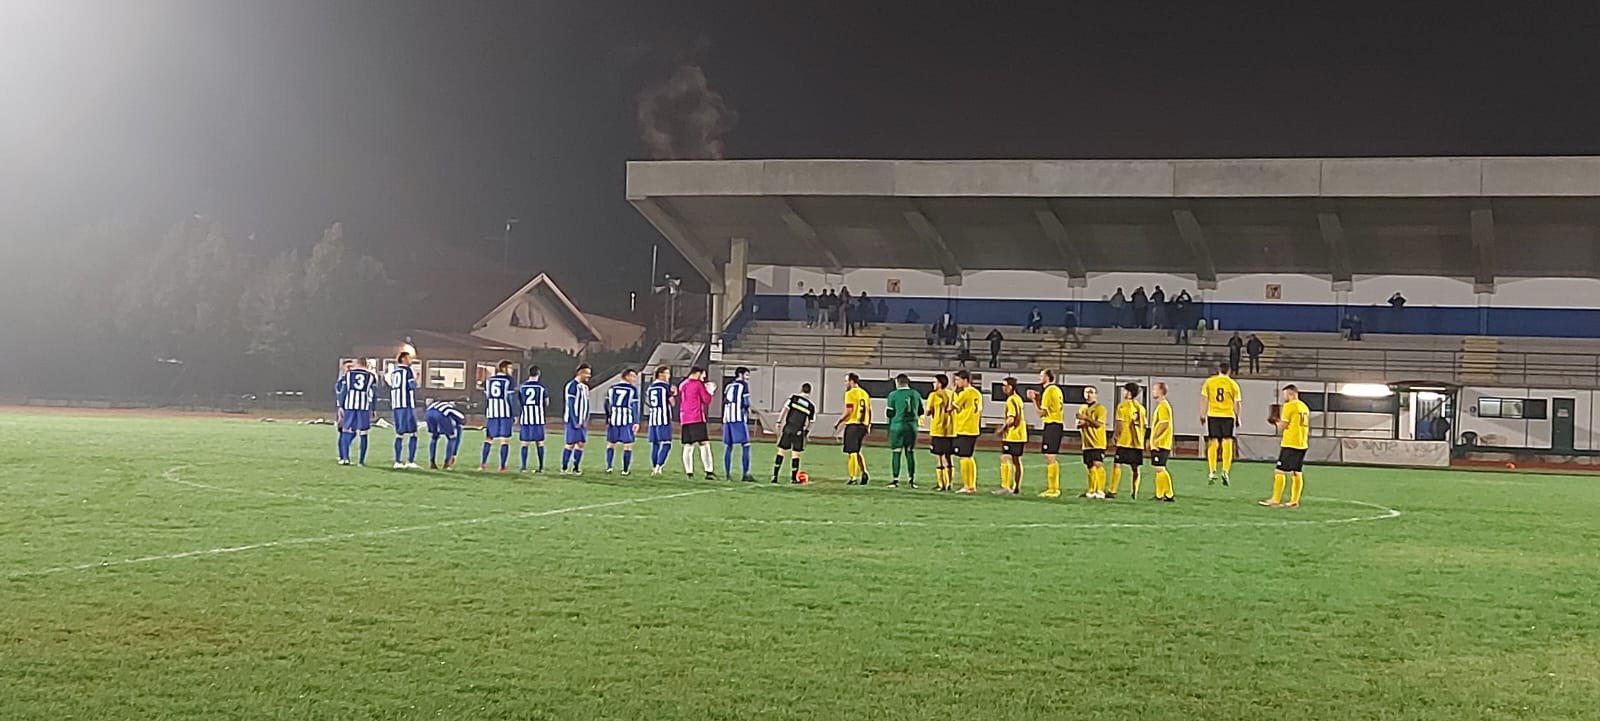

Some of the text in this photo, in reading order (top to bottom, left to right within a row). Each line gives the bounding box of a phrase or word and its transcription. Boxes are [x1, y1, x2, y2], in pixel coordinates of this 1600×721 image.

[353, 373, 365, 390] 3
[490, 380, 502, 397] 6
[525, 387, 536, 405] 2
[615, 390, 628, 407] 7
[650, 389, 658, 407] 5
[1216, 387, 1225, 402] 8
[859, 398, 866, 414] 9
